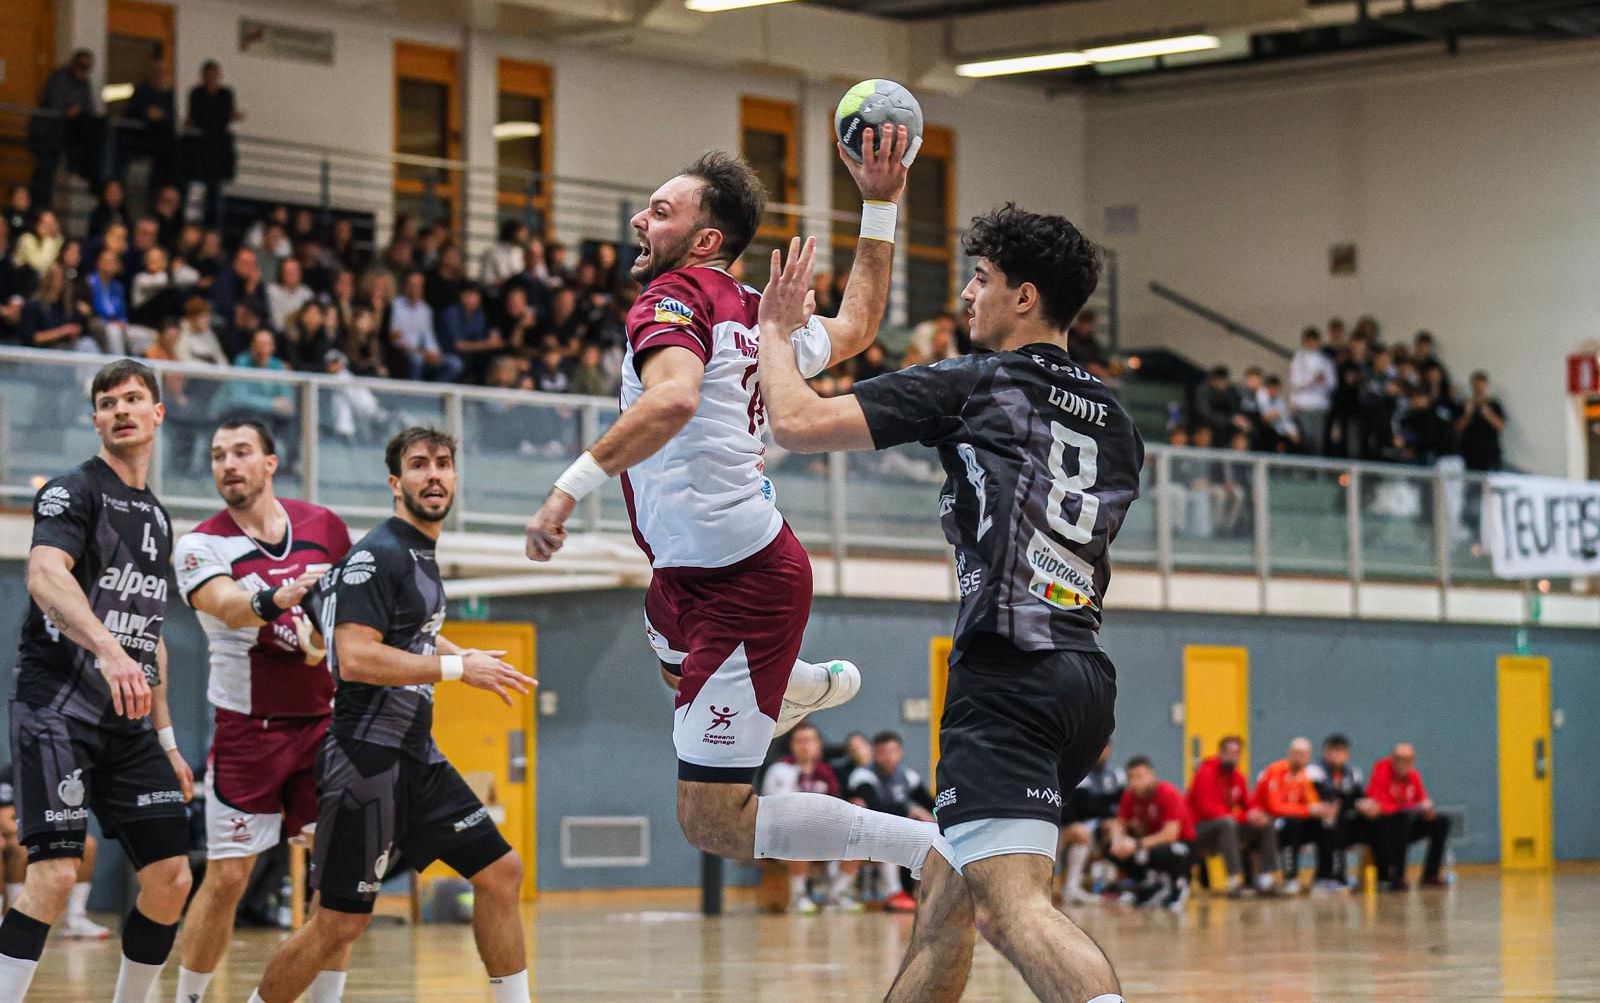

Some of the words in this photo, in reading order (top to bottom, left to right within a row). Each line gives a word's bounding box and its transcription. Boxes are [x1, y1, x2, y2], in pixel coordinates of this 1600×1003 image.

[1047, 385, 1108, 428] CONTE
[1046, 420, 1100, 545] 8
[141, 522, 158, 562] 4
